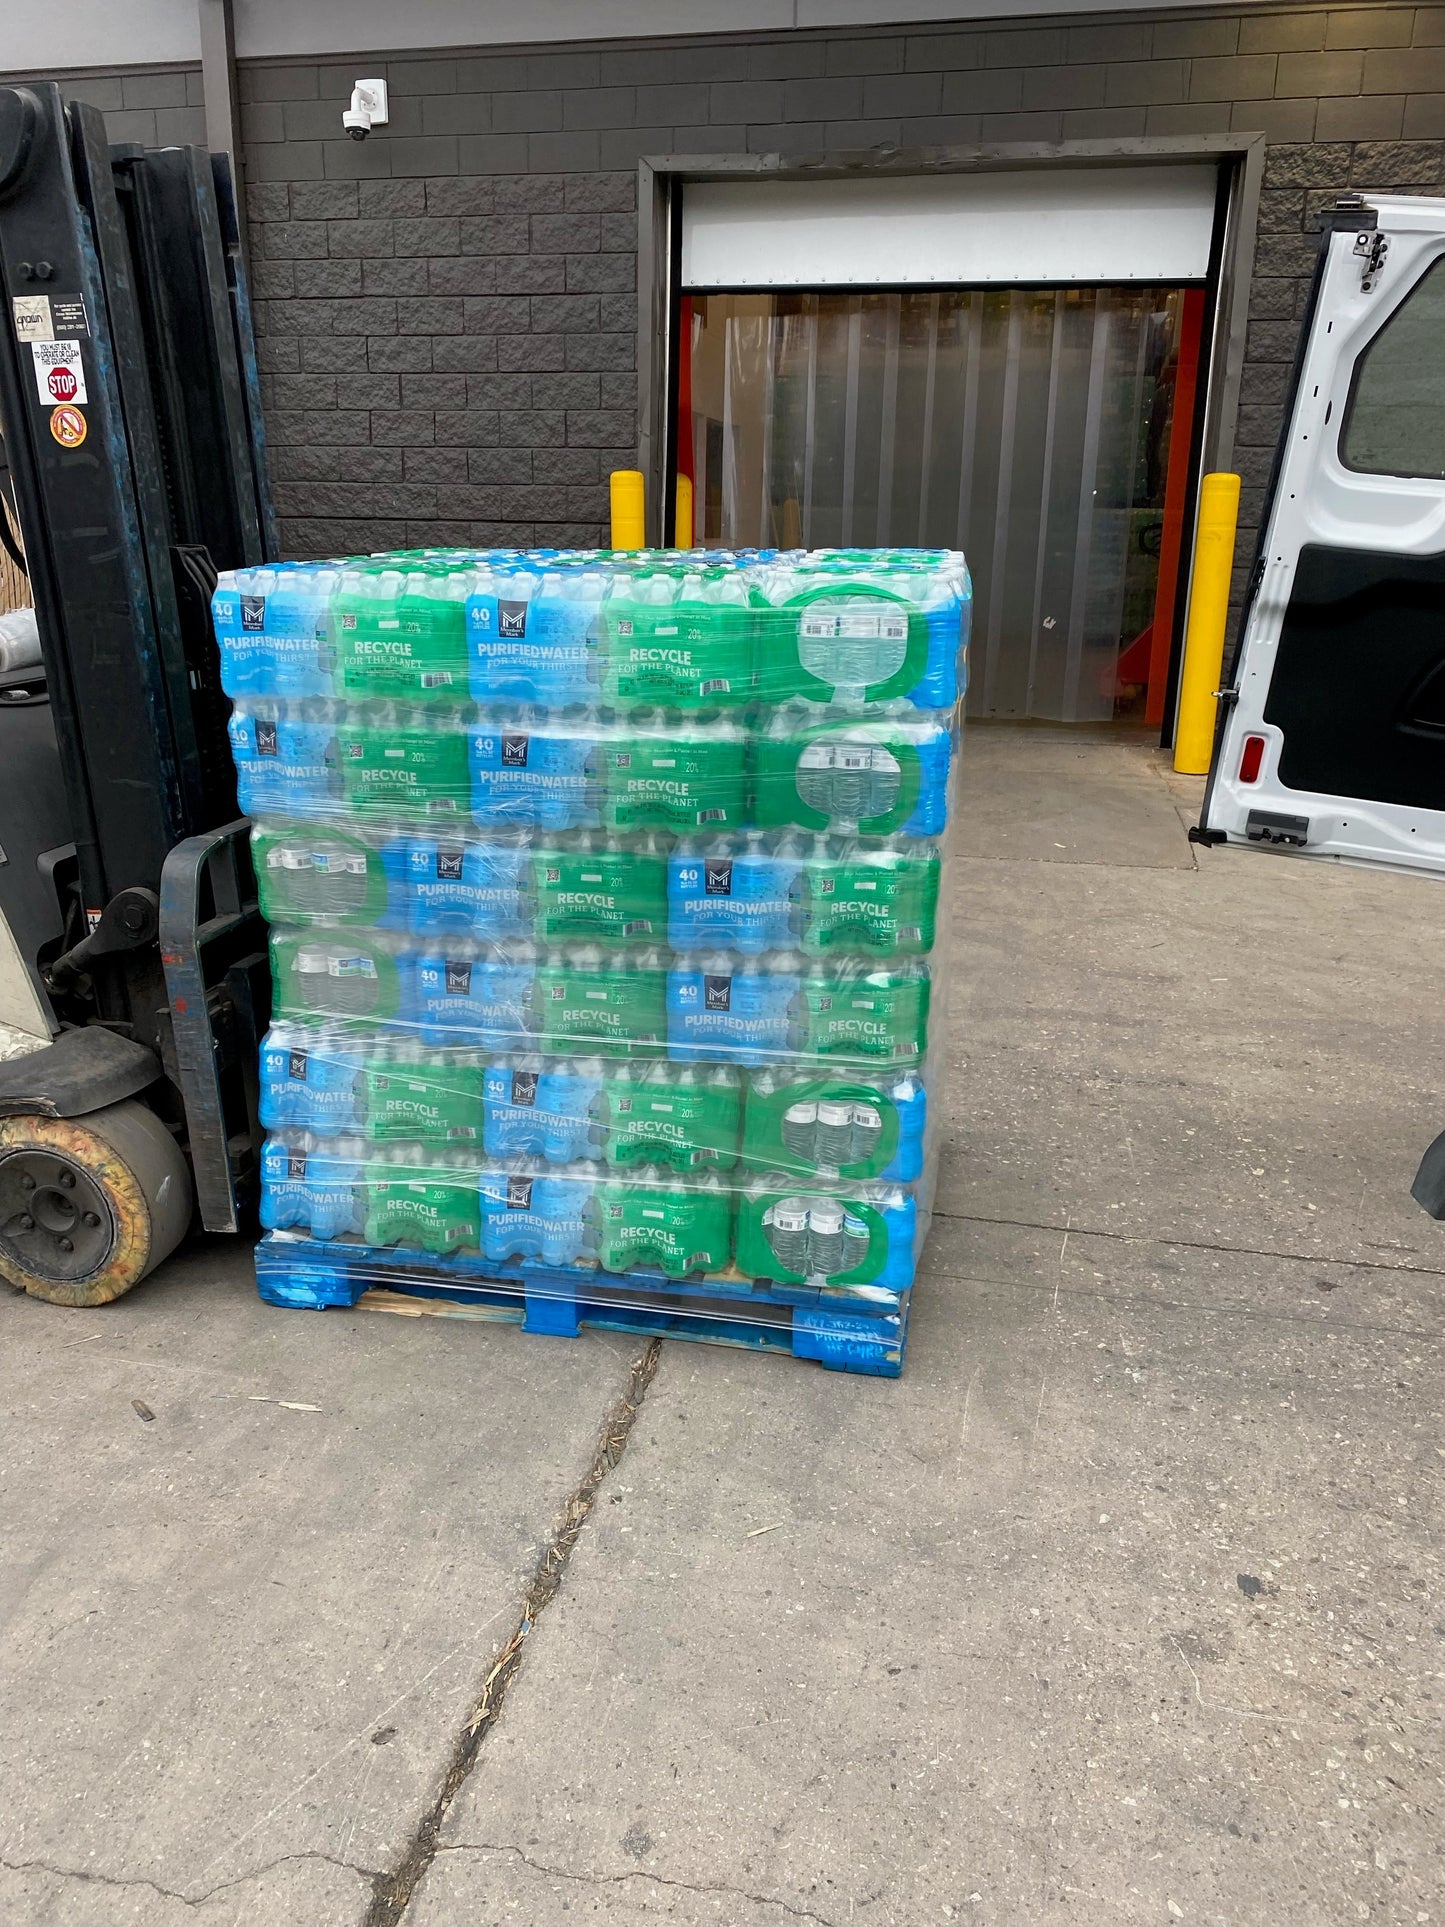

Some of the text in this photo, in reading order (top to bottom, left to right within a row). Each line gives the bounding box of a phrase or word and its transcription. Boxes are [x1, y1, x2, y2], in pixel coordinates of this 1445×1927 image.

[49, 375, 74, 393] STOP
[215, 604, 232, 615] 40
[472, 608, 490, 621] 40
[355, 641, 412, 656] RECYCLE
[233, 650, 252, 661] FOR
[390, 656, 422, 668] PLANET
[630, 649, 691, 665] RECYCLE
[488, 657, 508, 669] FOR
[511, 657, 538, 667] YOUR
[618, 664, 637, 673] FOR
[665, 663, 701, 677] PLANET
[475, 737, 493, 750] 40
[362, 770, 417, 785] RECYCLE
[628, 780, 689, 796] RECYCLE
[617, 795, 635, 803] FOR
[662, 795, 698, 806] PLANET
[411, 853, 428, 865] 40
[679, 869, 698, 880] 40
[426, 896, 445, 906] FOR
[558, 893, 614, 909] RECYCLE
[547, 907, 565, 915] FOR
[591, 908, 624, 919] PLANET
[831, 902, 889, 917] RECYCLE
[694, 911, 713, 923] FOR
[717, 911, 743, 926] YOUR
[821, 916, 837, 927] FOR
[864, 915, 897, 928] PLANET
[421, 970, 438, 980] 40
[680, 986, 697, 996] 40
[563, 1010, 620, 1025] RECYCLE
[596, 1023, 629, 1035] PLANET
[693, 1026, 713, 1036] FOR
[829, 1020, 887, 1034] RECYCLE
[819, 1031, 895, 1045] FOR THE PLANET
[266, 1055, 283, 1065] 40
[488, 1081, 504, 1091] 40
[386, 1100, 439, 1117] RECYCLE
[376, 1112, 393, 1120] FOR
[417, 1115, 448, 1127] PLANET
[628, 1121, 684, 1138] RECYCLE
[266, 1158, 280, 1167] 40
[387, 1200, 437, 1217] RECYCLE
[377, 1212, 394, 1220] FOR
[417, 1215, 447, 1226] PLANET
[496, 1225, 514, 1236] FOR
[621, 1227, 675, 1245] RECYCLE
[652, 1239, 684, 1255] PLANET
